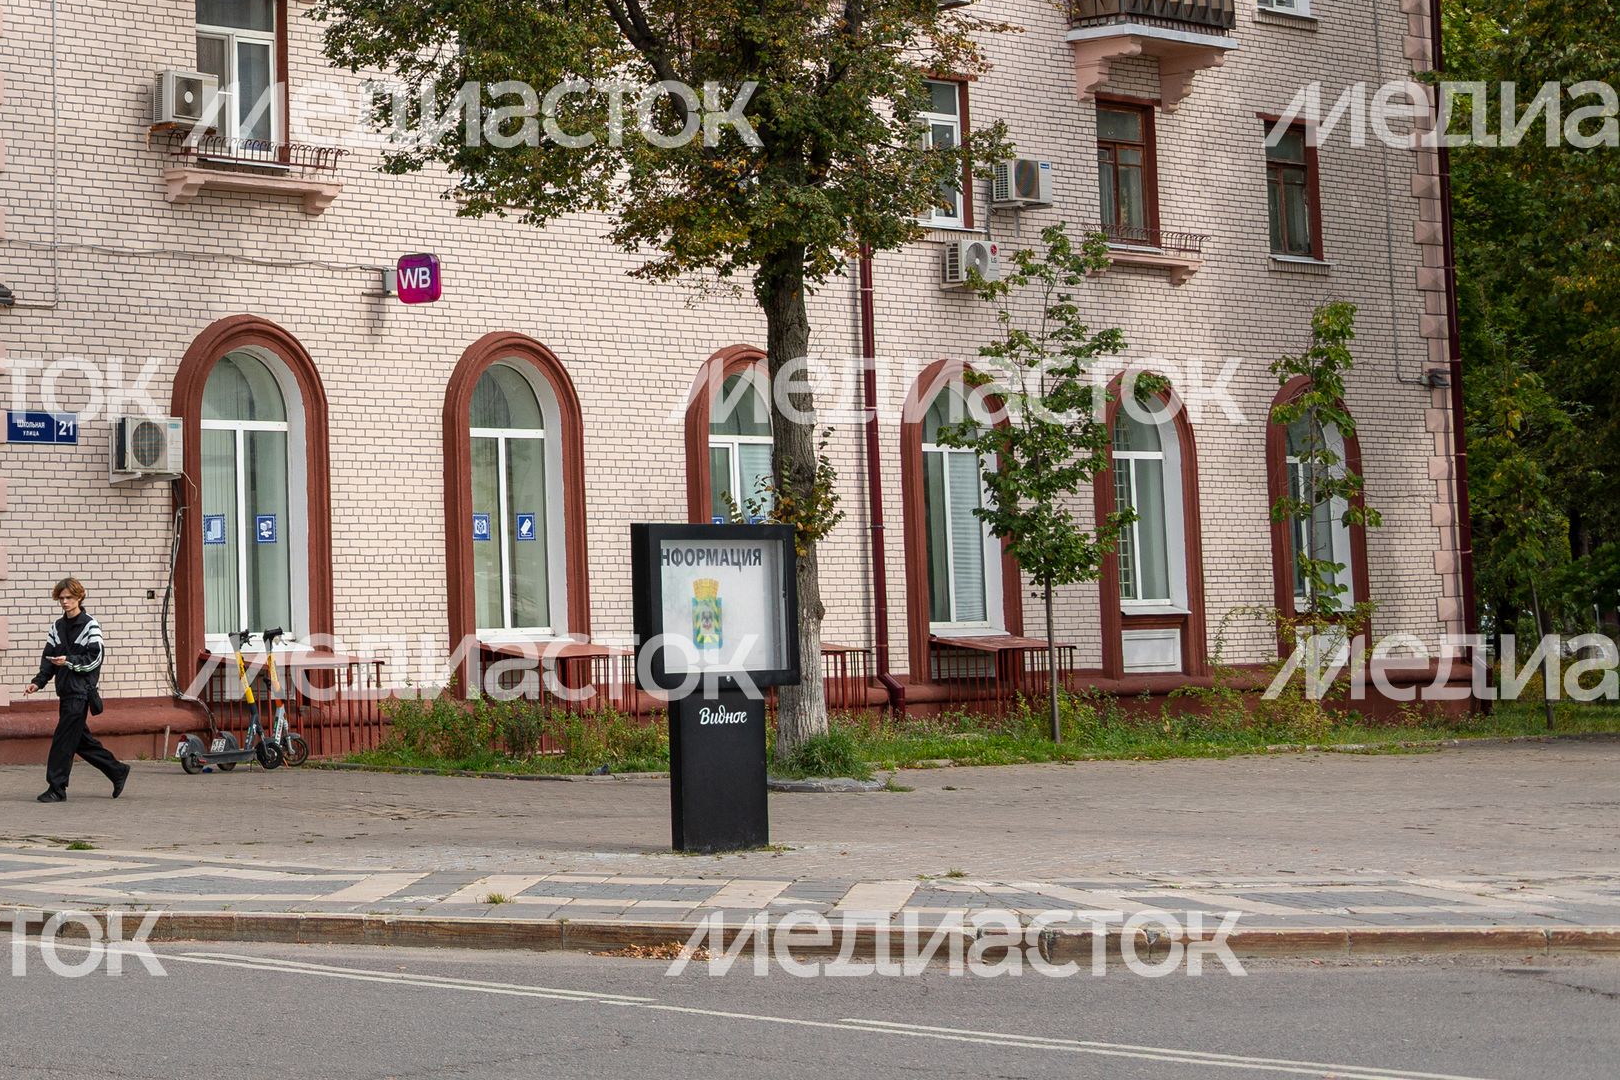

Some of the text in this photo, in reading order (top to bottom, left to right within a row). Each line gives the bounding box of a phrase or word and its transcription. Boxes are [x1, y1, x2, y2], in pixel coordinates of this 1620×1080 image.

[398, 266, 431, 290] WB
[58, 420, 74, 436] 21
[661, 548, 762, 572] НФОРМАЦИЯ
[698, 705, 748, 725] Видное
